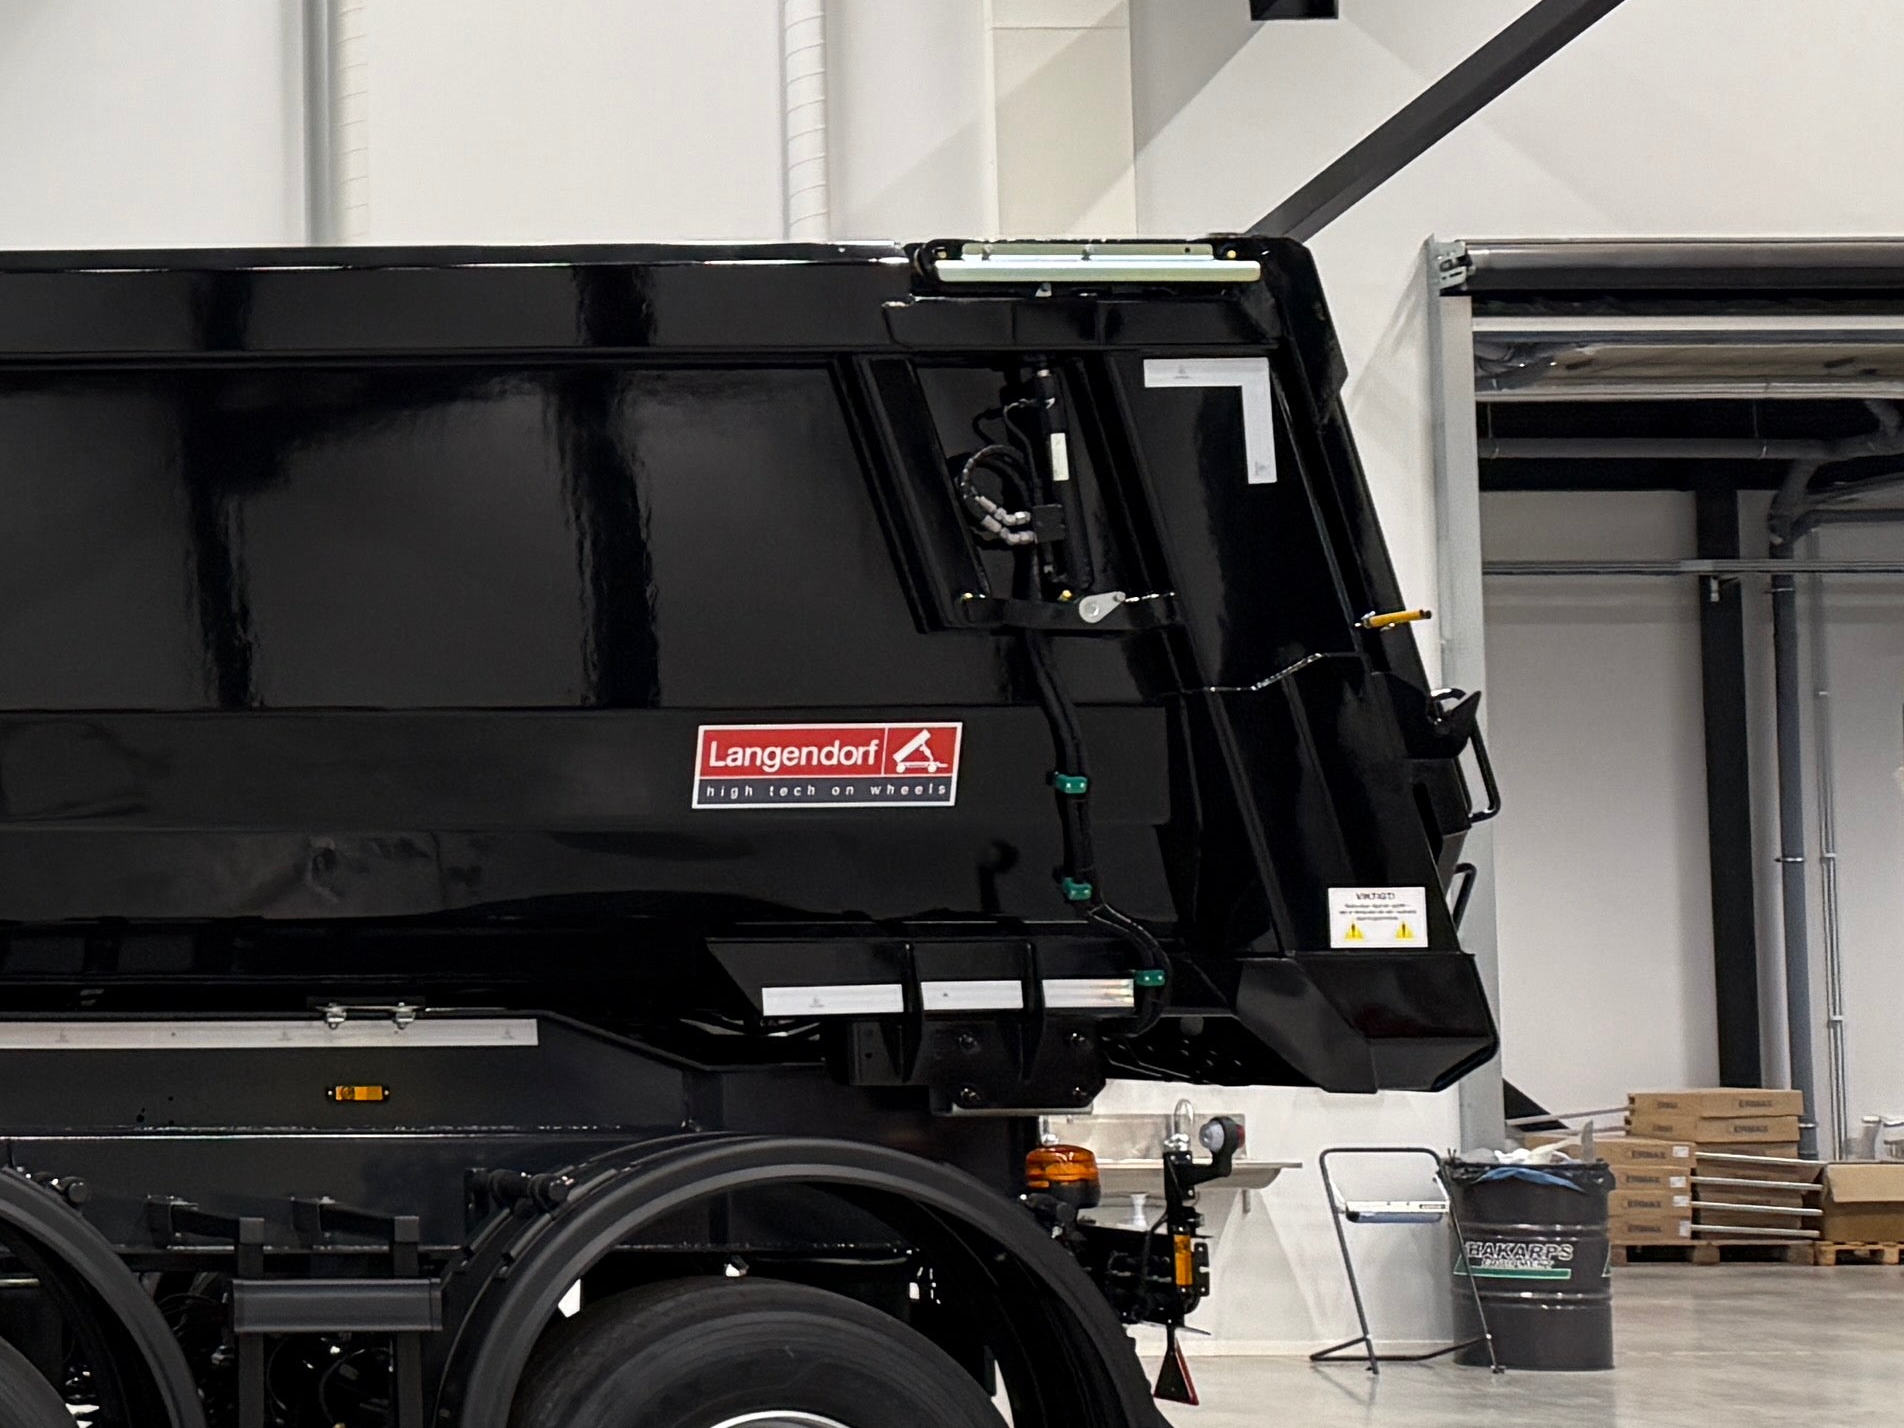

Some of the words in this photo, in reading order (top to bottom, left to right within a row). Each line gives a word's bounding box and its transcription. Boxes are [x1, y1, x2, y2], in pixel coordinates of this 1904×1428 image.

[709, 739, 879, 772] Langendorf
[707, 785, 753, 799] high
[769, 785, 816, 797] tech
[831, 785, 855, 797] on
[870, 783, 946, 797] wheels
[1465, 1241, 1573, 1260] HAKARPS
